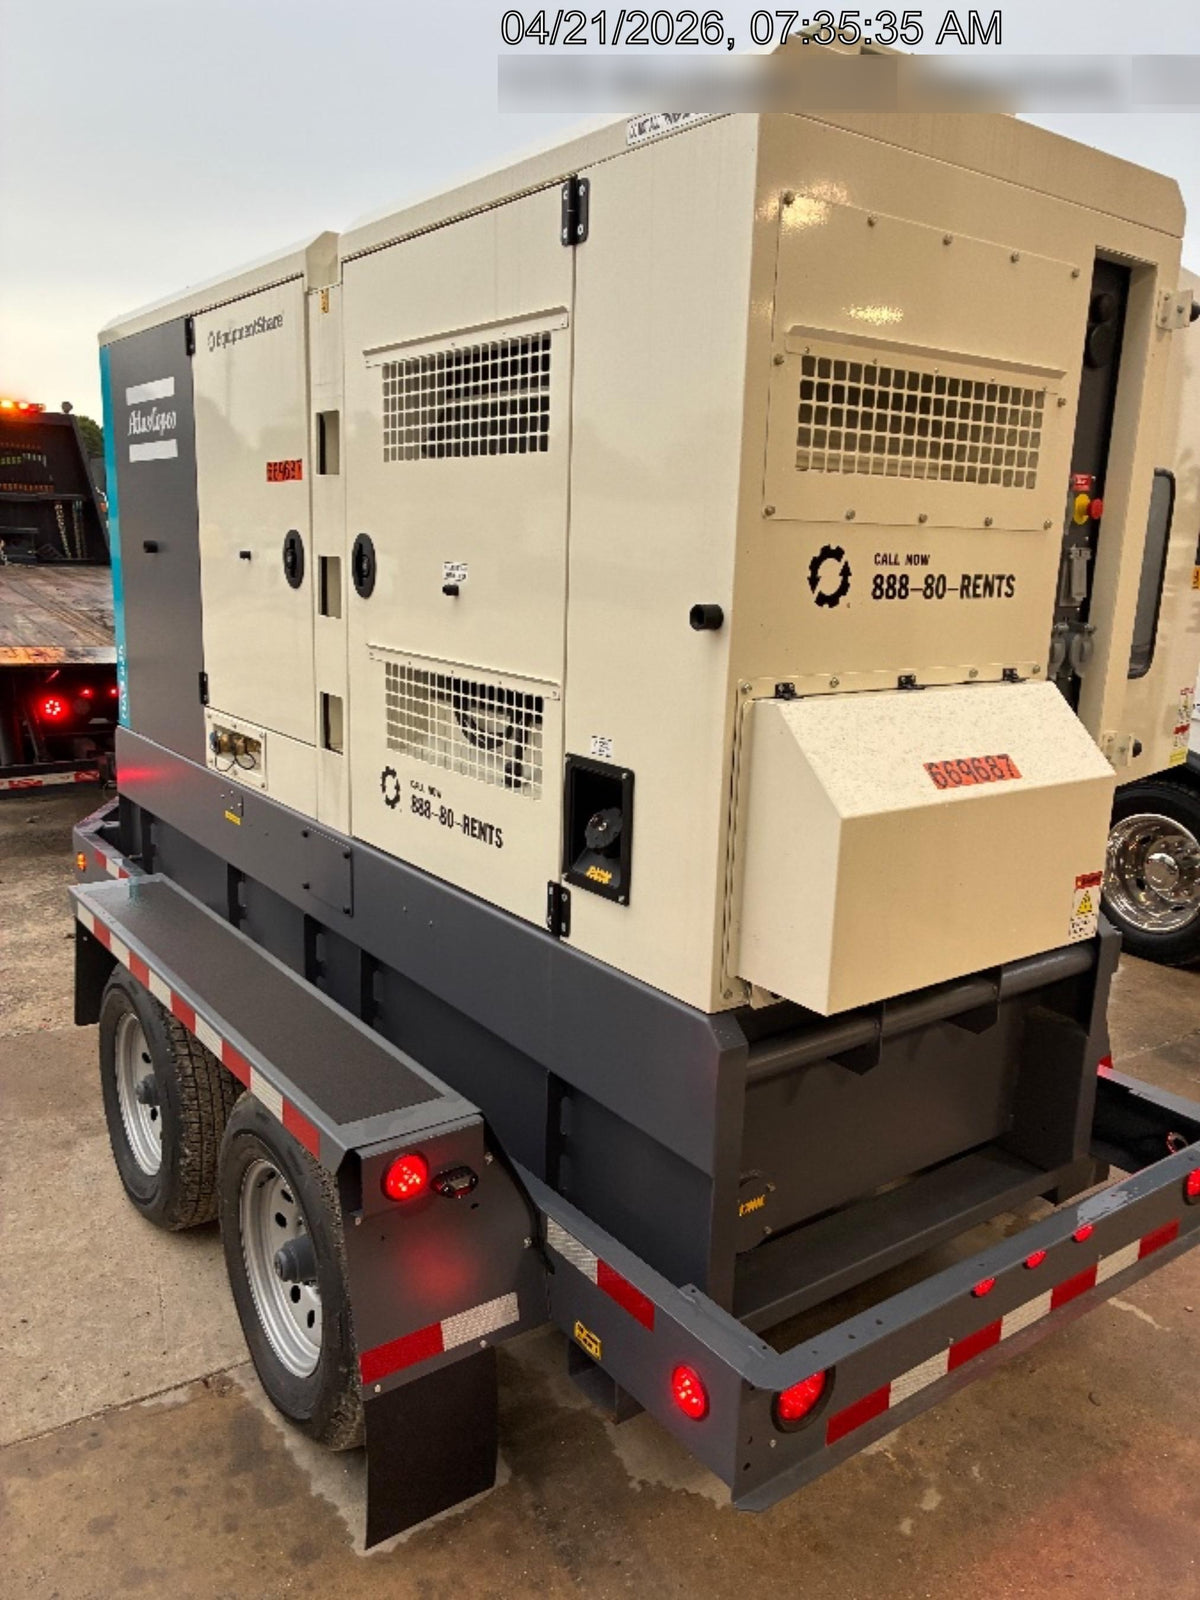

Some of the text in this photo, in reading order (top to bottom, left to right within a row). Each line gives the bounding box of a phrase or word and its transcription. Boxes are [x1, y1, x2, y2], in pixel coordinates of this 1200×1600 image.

[874, 553, 930, 566] CALL NOW
[871, 574, 1016, 600] 888-80-RENTS
[410, 795, 503, 848] 888-80-RENTS
